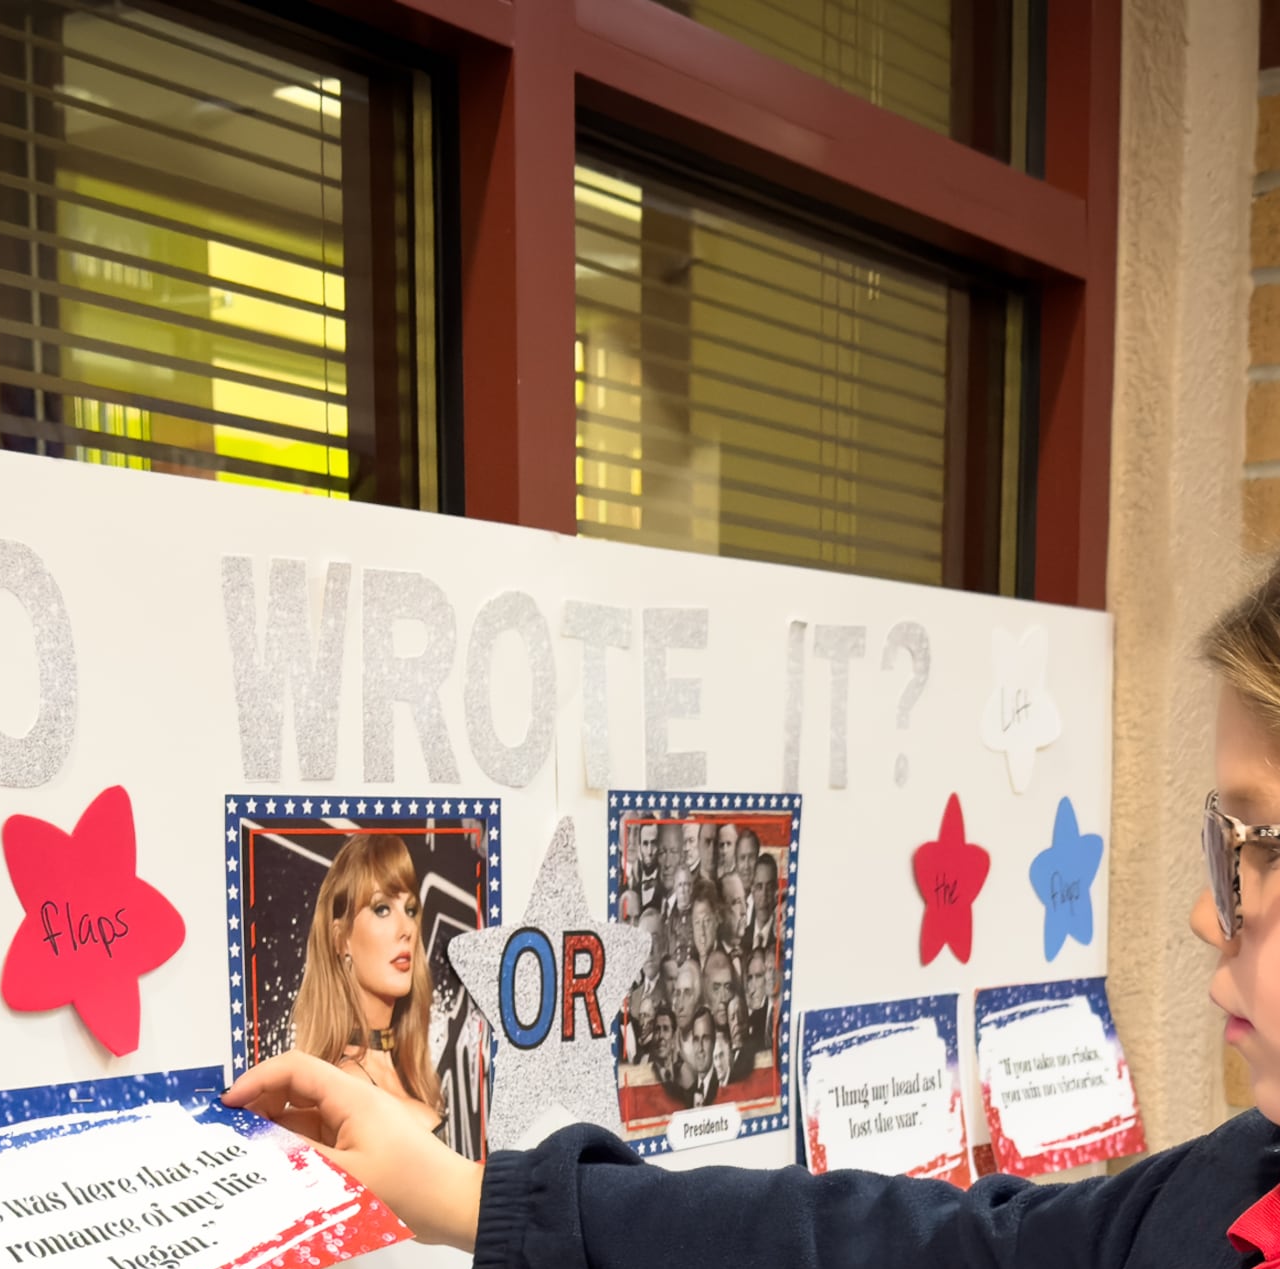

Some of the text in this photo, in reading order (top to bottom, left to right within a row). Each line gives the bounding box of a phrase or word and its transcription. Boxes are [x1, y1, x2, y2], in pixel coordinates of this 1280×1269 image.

[220, 555, 708, 796] WROTE
[782, 619, 931, 794] IT?
[1000, 685, 1032, 733] Lift
[933, 872, 959, 908] the
[40, 900, 129, 958] flaps
[498, 925, 607, 1051] OR
[1013, 1059, 1032, 1079] you
[1033, 1051, 1055, 1070] take
[1056, 1053, 1070, 1066] no
[841, 1083, 870, 1109] hung
[871, 1083, 889, 1105] my
[891, 1072, 921, 1098] head
[922, 1075, 936, 1092] as
[937, 1068, 942, 1089] I
[1001, 1089, 1021, 1109] you
[1022, 1080, 1042, 1100] win
[1043, 1083, 1057, 1097] no
[683, 1115, 729, 1139] Presidents
[848, 1117, 872, 1139] lost
[873, 1112, 894, 1134] the
[2, 1190, 68, 1219] was
[61, 1176, 138, 1206] here
[135, 1160, 199, 1190] that
[196, 1144, 248, 1169] the
[4, 1169, 268, 1264] romance of my life
